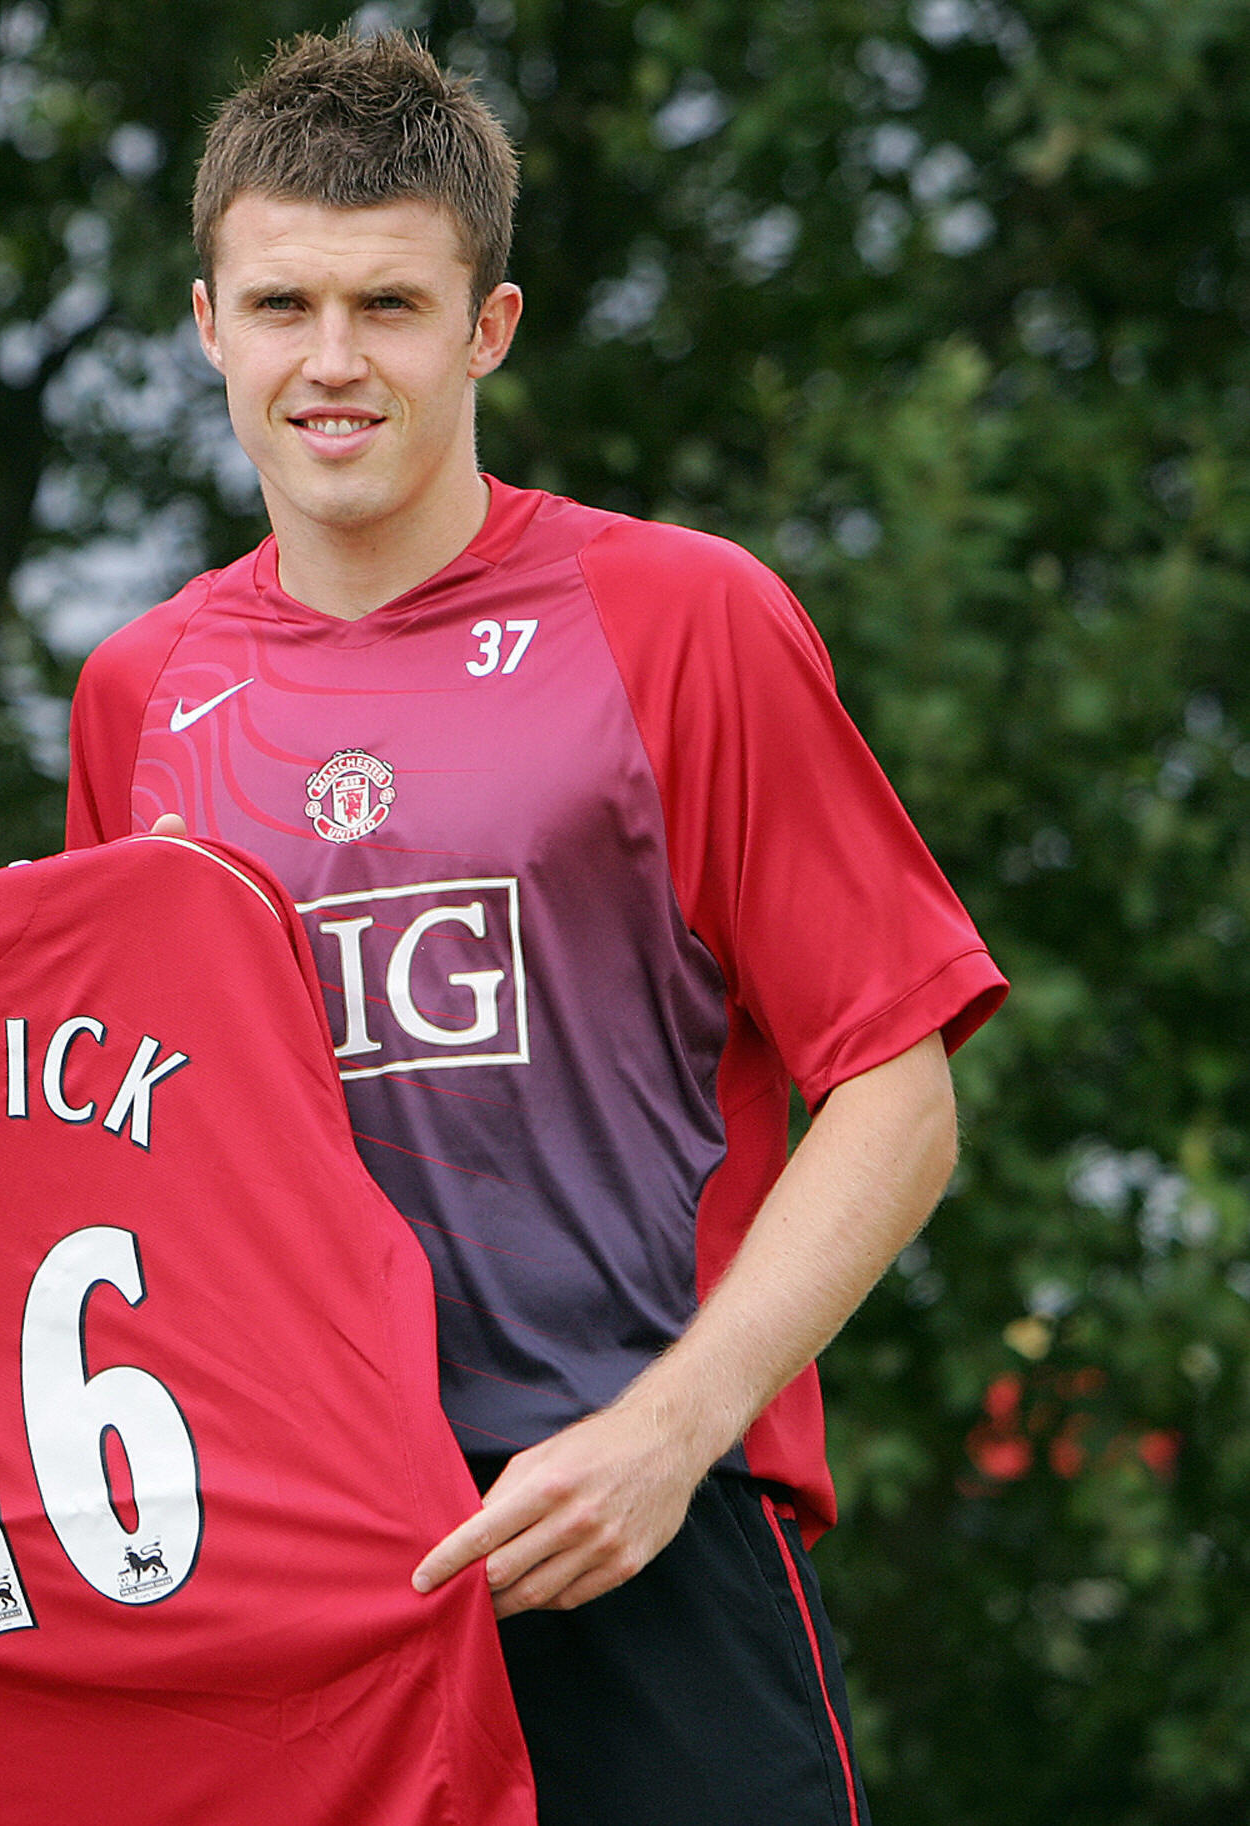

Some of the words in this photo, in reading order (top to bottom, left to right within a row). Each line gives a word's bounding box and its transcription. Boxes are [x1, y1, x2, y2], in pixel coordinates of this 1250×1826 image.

[465, 619, 539, 677] 37
[313, 756, 388, 793] MANCHESTER
[327, 818, 377, 840] UNITED
